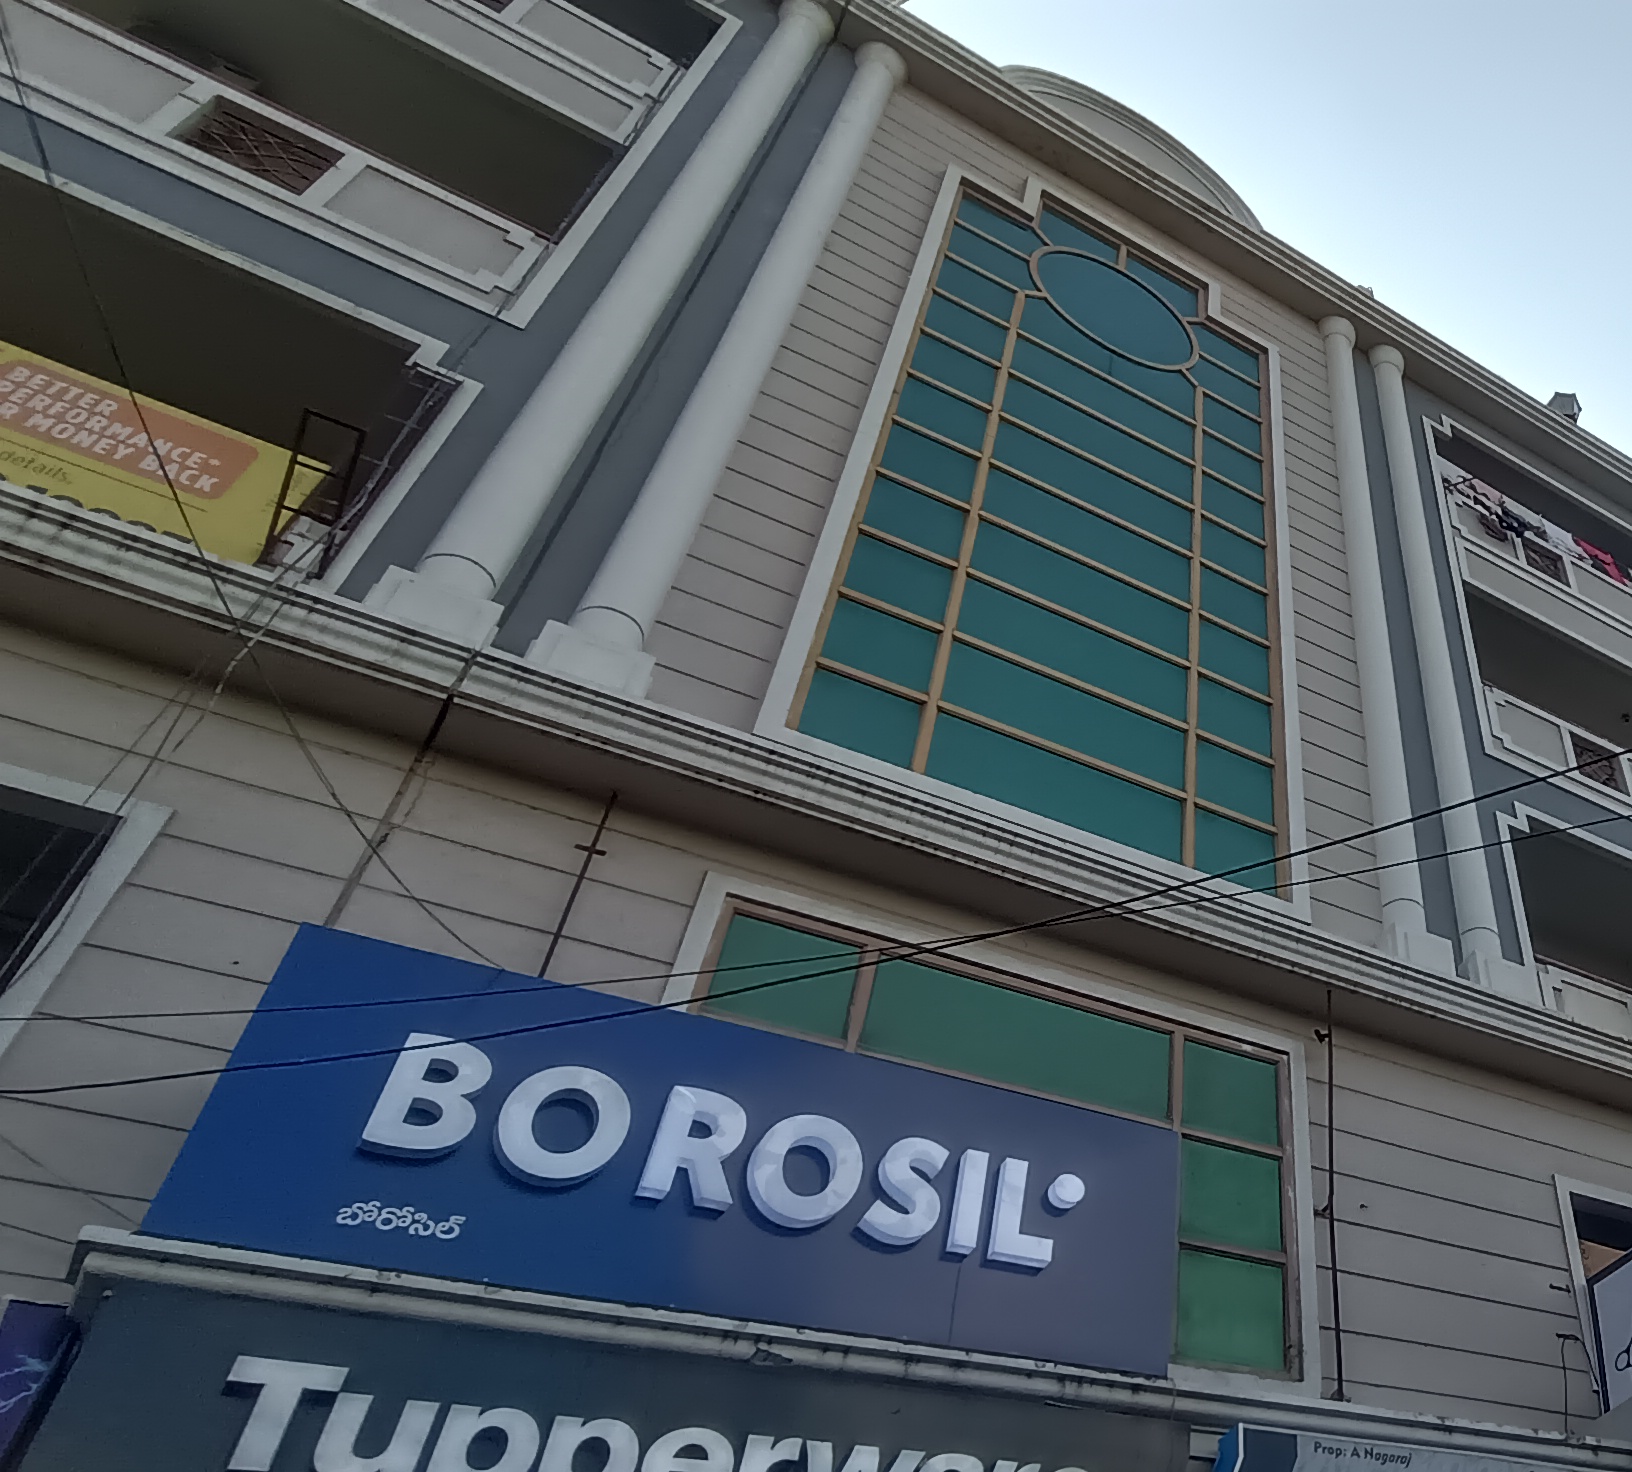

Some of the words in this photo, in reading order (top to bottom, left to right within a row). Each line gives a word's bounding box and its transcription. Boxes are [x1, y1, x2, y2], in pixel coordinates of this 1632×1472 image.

[5, 366, 118, 416] BETTER
[22, 413, 136, 460] MONEY
[138, 454, 220, 493] BACK
[358, 1032, 1056, 1268] BOROSIL
[336, 1200, 467, 1240] బోరోసిల్
[1313, 1441, 1347, 1459] Prop:
[1350, 1446, 1361, 1458] A
